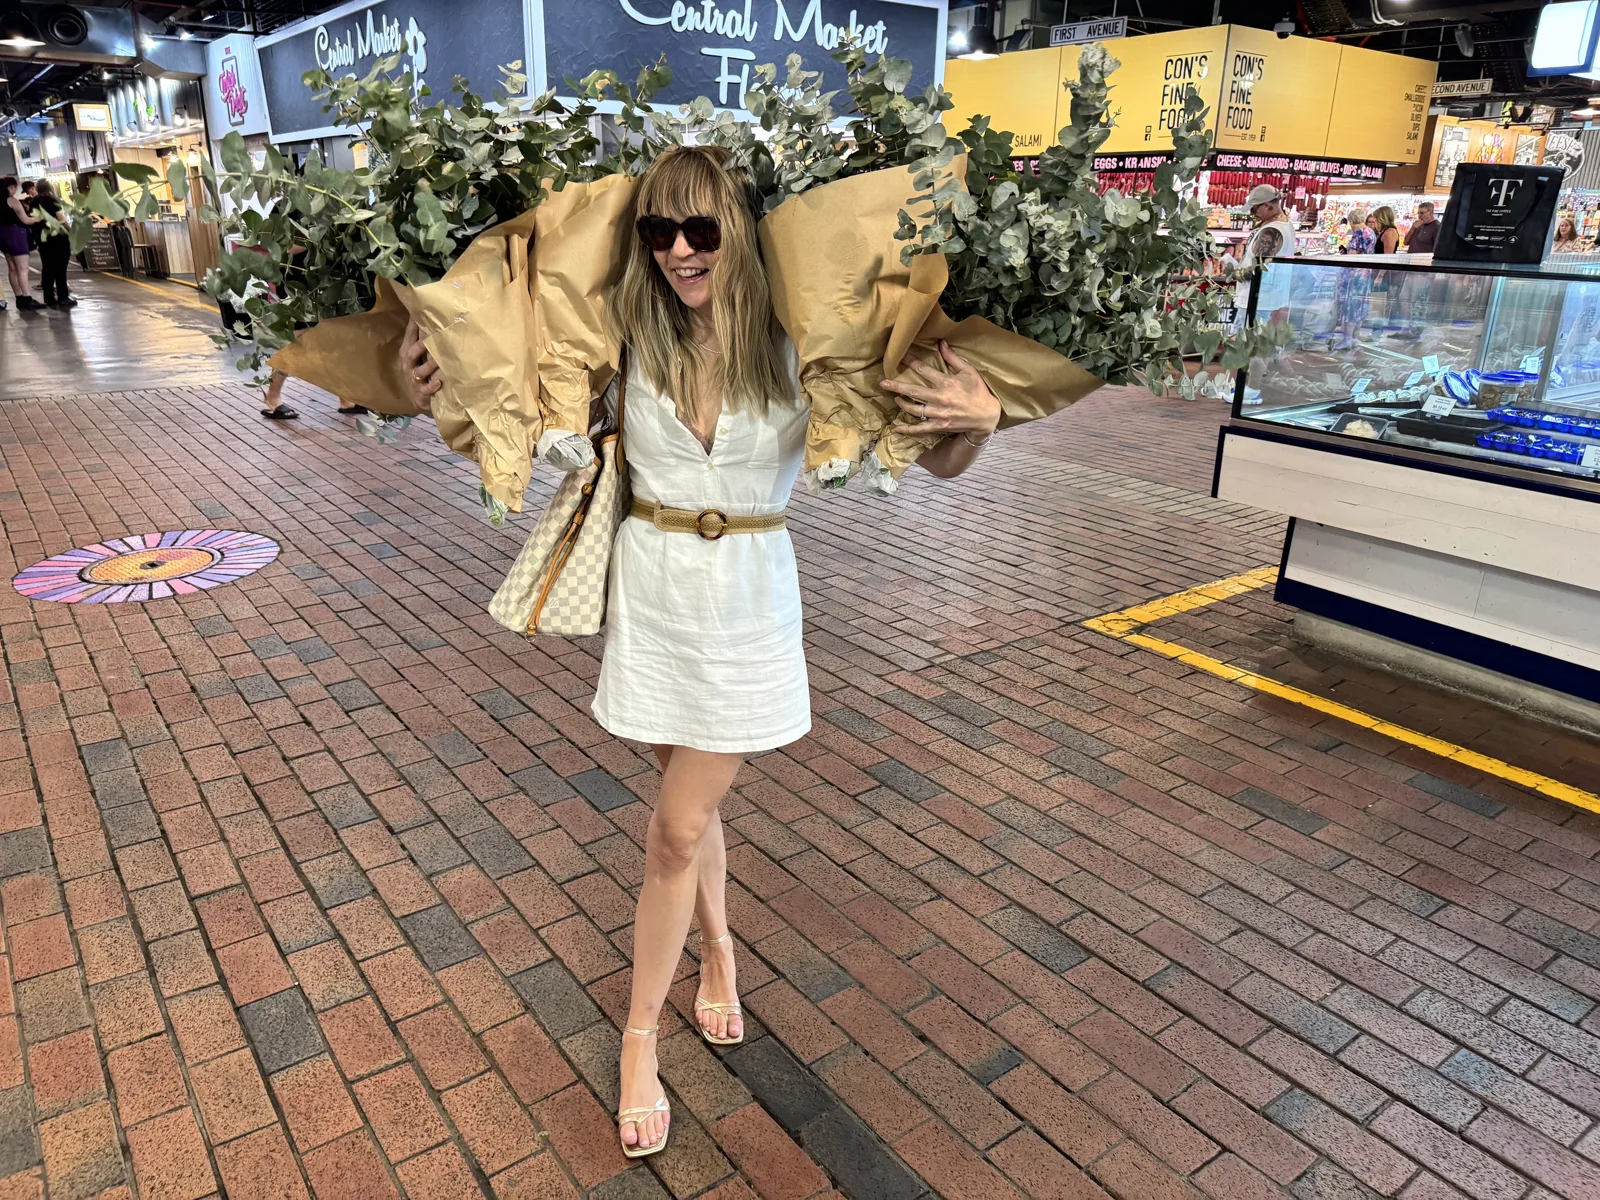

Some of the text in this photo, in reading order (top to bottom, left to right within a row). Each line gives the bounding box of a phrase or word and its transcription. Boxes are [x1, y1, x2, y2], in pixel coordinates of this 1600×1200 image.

[315, 9, 402, 72] Central Market
[1053, 21, 1120, 41] FIRST AVENUE
[1164, 55, 1208, 80] CON'S
[1233, 54, 1264, 80] CON'S
[1229, 80, 1252, 105] FINE
[1456, 82, 1486, 92] AVENUE
[1225, 106, 1253, 130] FOOD
[1015, 134, 1041, 147] SALAMI
[1094, 158, 1117, 169] EGGS
[1217, 154, 1242, 167] CHEESE
[1247, 156, 1289, 170] SMALLGOODS
[1294, 161, 1316, 172] BACON
[1320, 163, 1340, 174] OLIVES
[1343, 164, 1357, 176] DIPS
[1361, 166, 1383, 179] SALAMI
